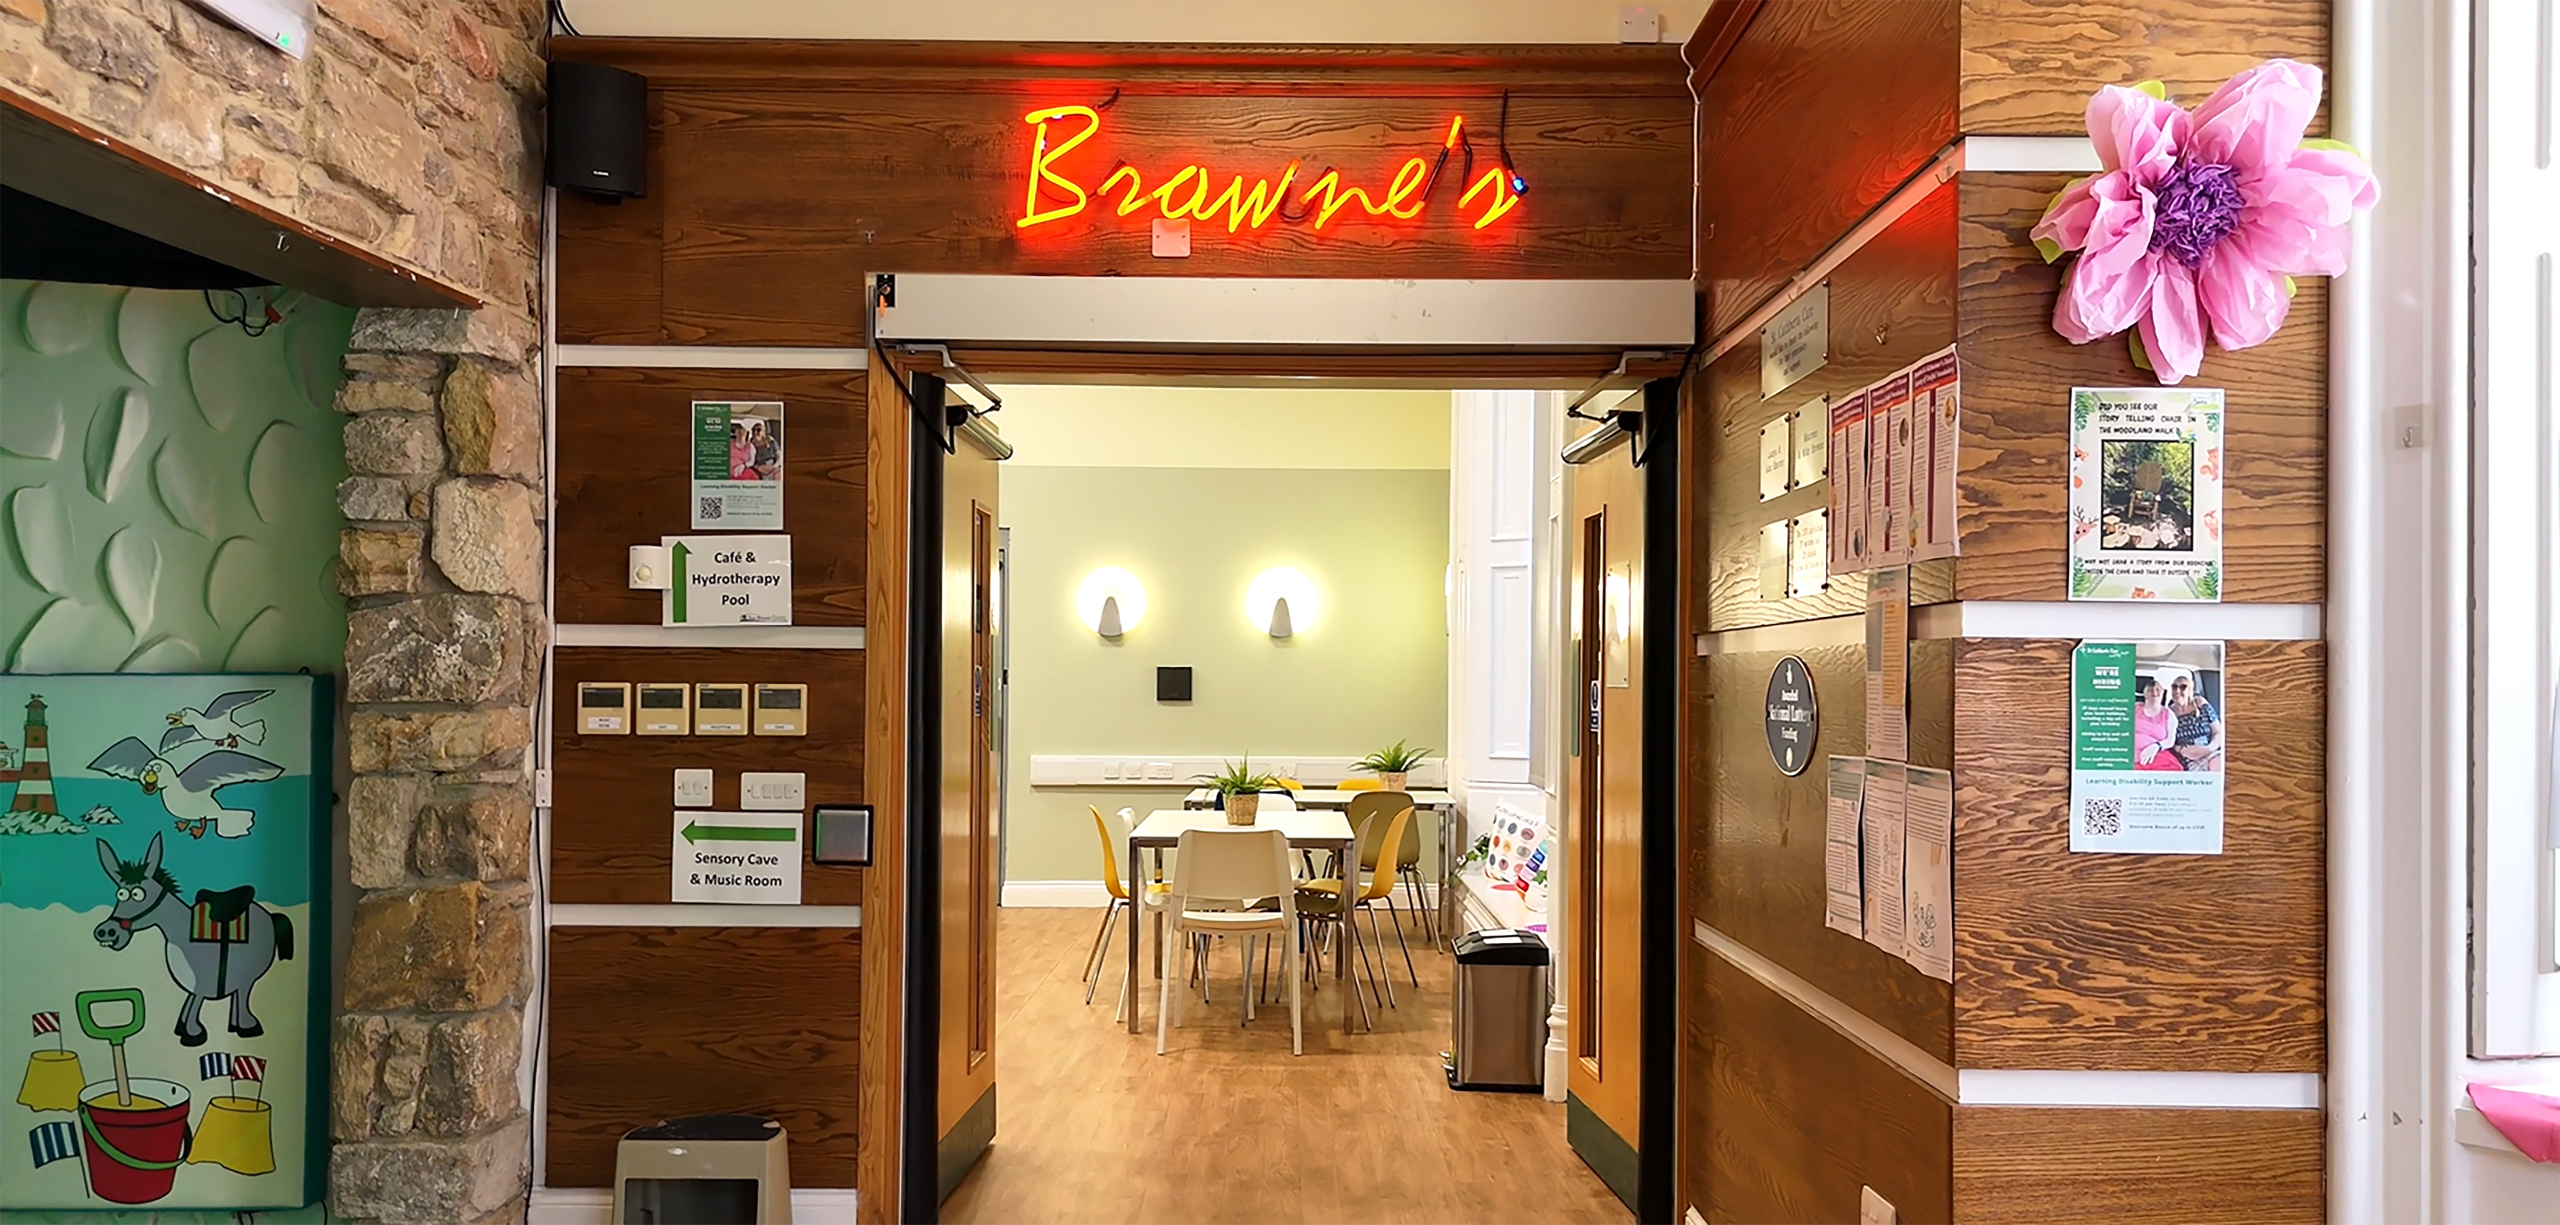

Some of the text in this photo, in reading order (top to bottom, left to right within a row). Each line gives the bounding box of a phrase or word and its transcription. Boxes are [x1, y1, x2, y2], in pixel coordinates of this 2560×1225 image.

[1017, 105, 1522, 233] Browne's
[2099, 402, 2112, 410] DID
[714, 551, 756, 564] Café &
[692, 572, 780, 588] Hydrotherapy
[722, 594, 750, 605] Pool
[694, 852, 778, 867] Sensory Cave
[690, 873, 782, 886] & Music Room
